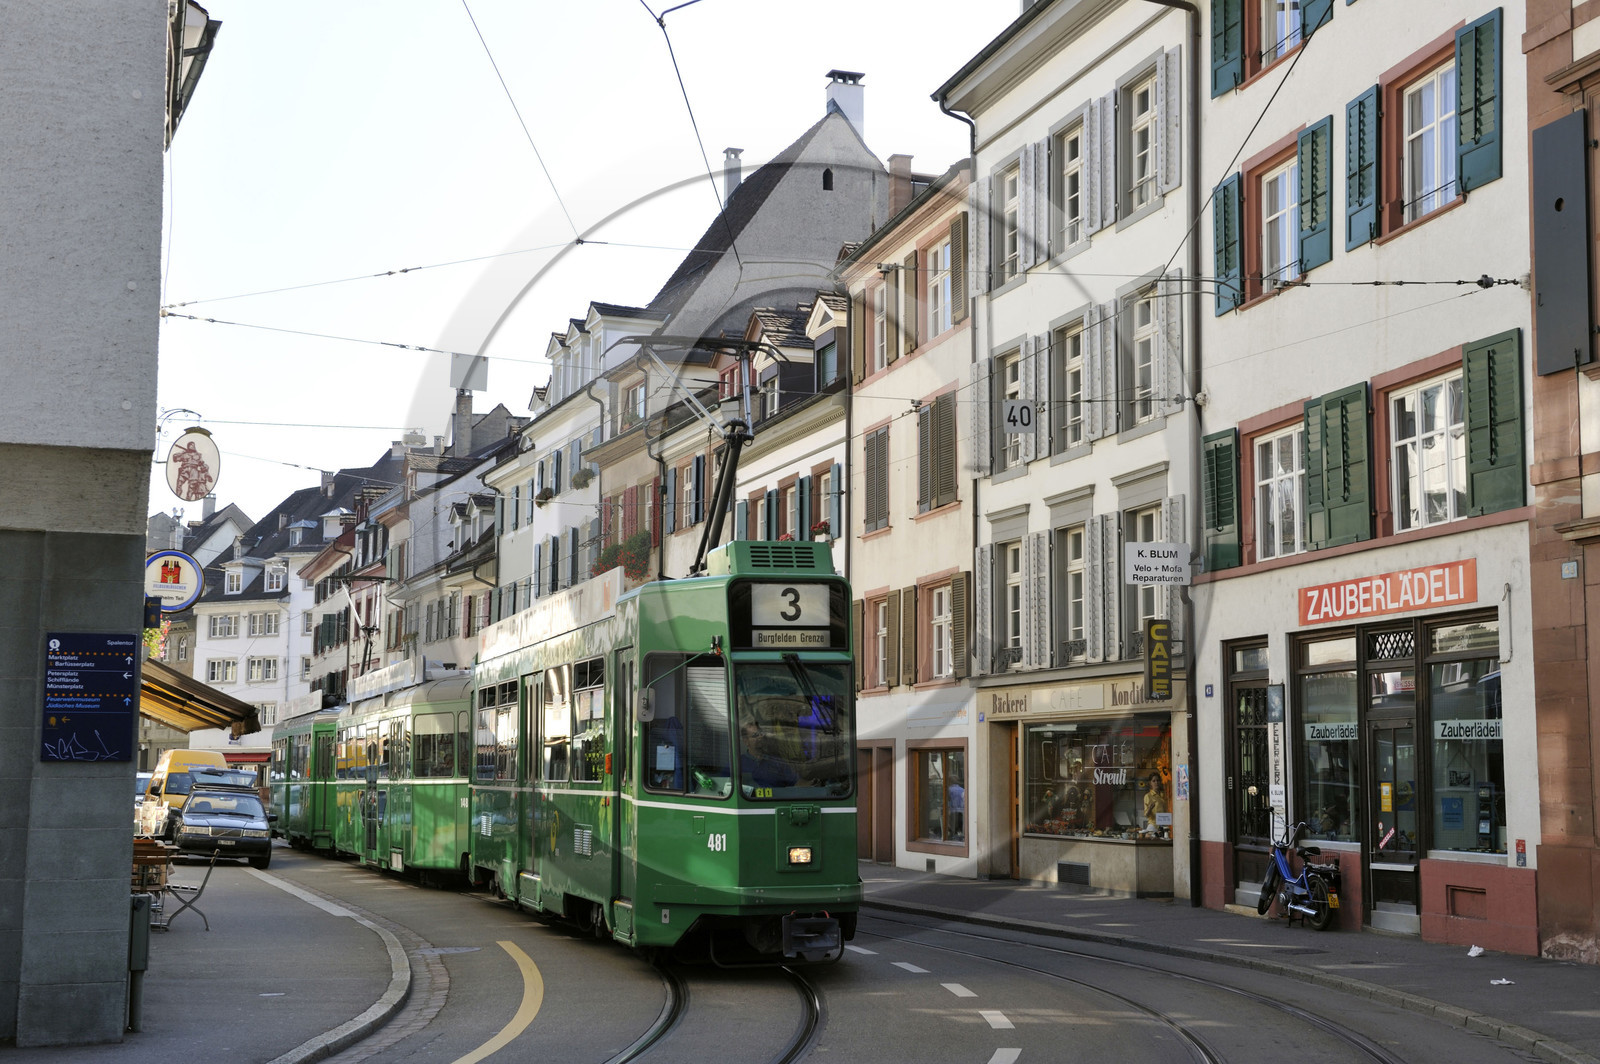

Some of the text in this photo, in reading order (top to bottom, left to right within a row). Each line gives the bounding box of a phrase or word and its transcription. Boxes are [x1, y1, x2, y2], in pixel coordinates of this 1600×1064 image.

[1007, 406, 1031, 427] 40
[1138, 550, 1178, 558] K. BLUM
[1134, 564, 1152, 572] Velo
[1132, 574, 1184, 582] Reparaturen
[1307, 565, 1464, 621] ZAUBERLÄDELI
[780, 587, 802, 622] 3
[758, 632, 825, 644] Burgfelden Grenze
[1150, 624, 1169, 695] CAFE
[992, 693, 1027, 714] Bäckerei
[1441, 722, 1500, 737] Zauberlädeli
[1091, 740, 1126, 765] CAFÉ
[1093, 768, 1127, 785] Streuli
[707, 833, 727, 851] 481
